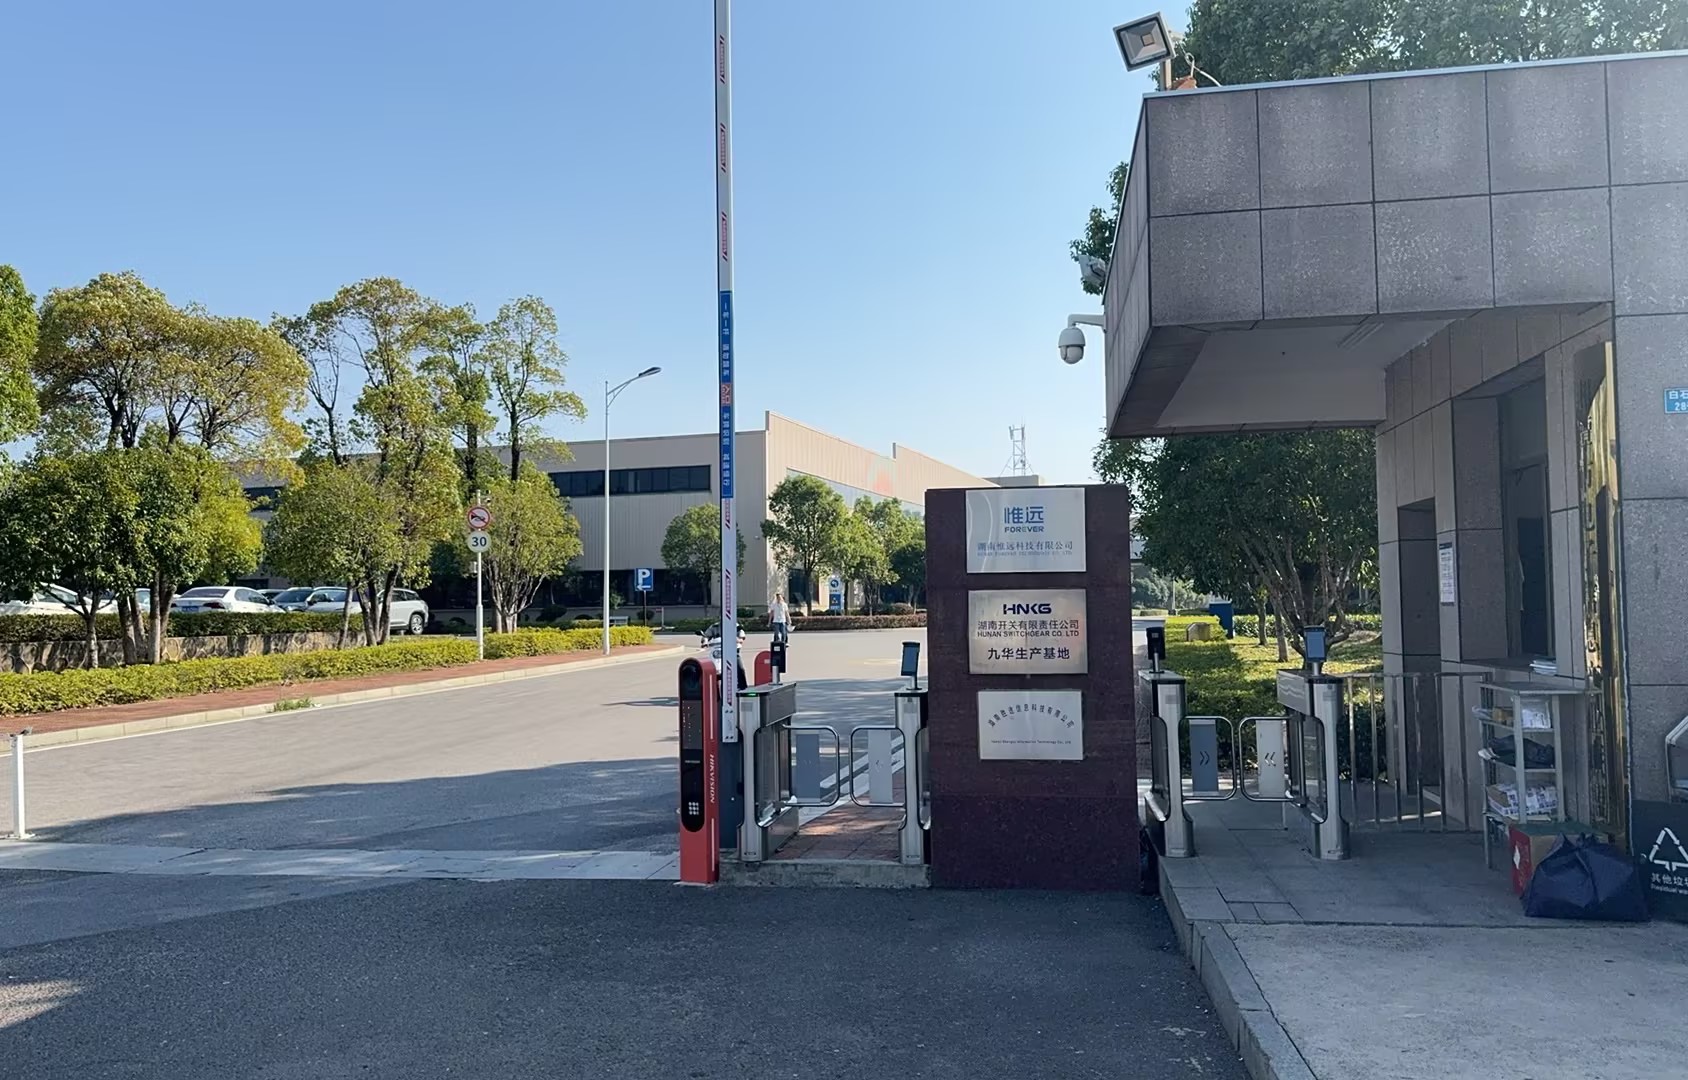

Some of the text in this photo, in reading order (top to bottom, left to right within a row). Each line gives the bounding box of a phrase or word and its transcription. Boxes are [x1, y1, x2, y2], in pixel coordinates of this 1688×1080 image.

[1004, 506, 1044, 524] 惟远
[471, 536, 487, 547] 30
[637, 568, 650, 586] P
[1003, 603, 1052, 615] HNKG
[977, 620, 1080, 630] 湖南开关有限责任公司
[987, 647, 1070, 660] 九华生产基地
